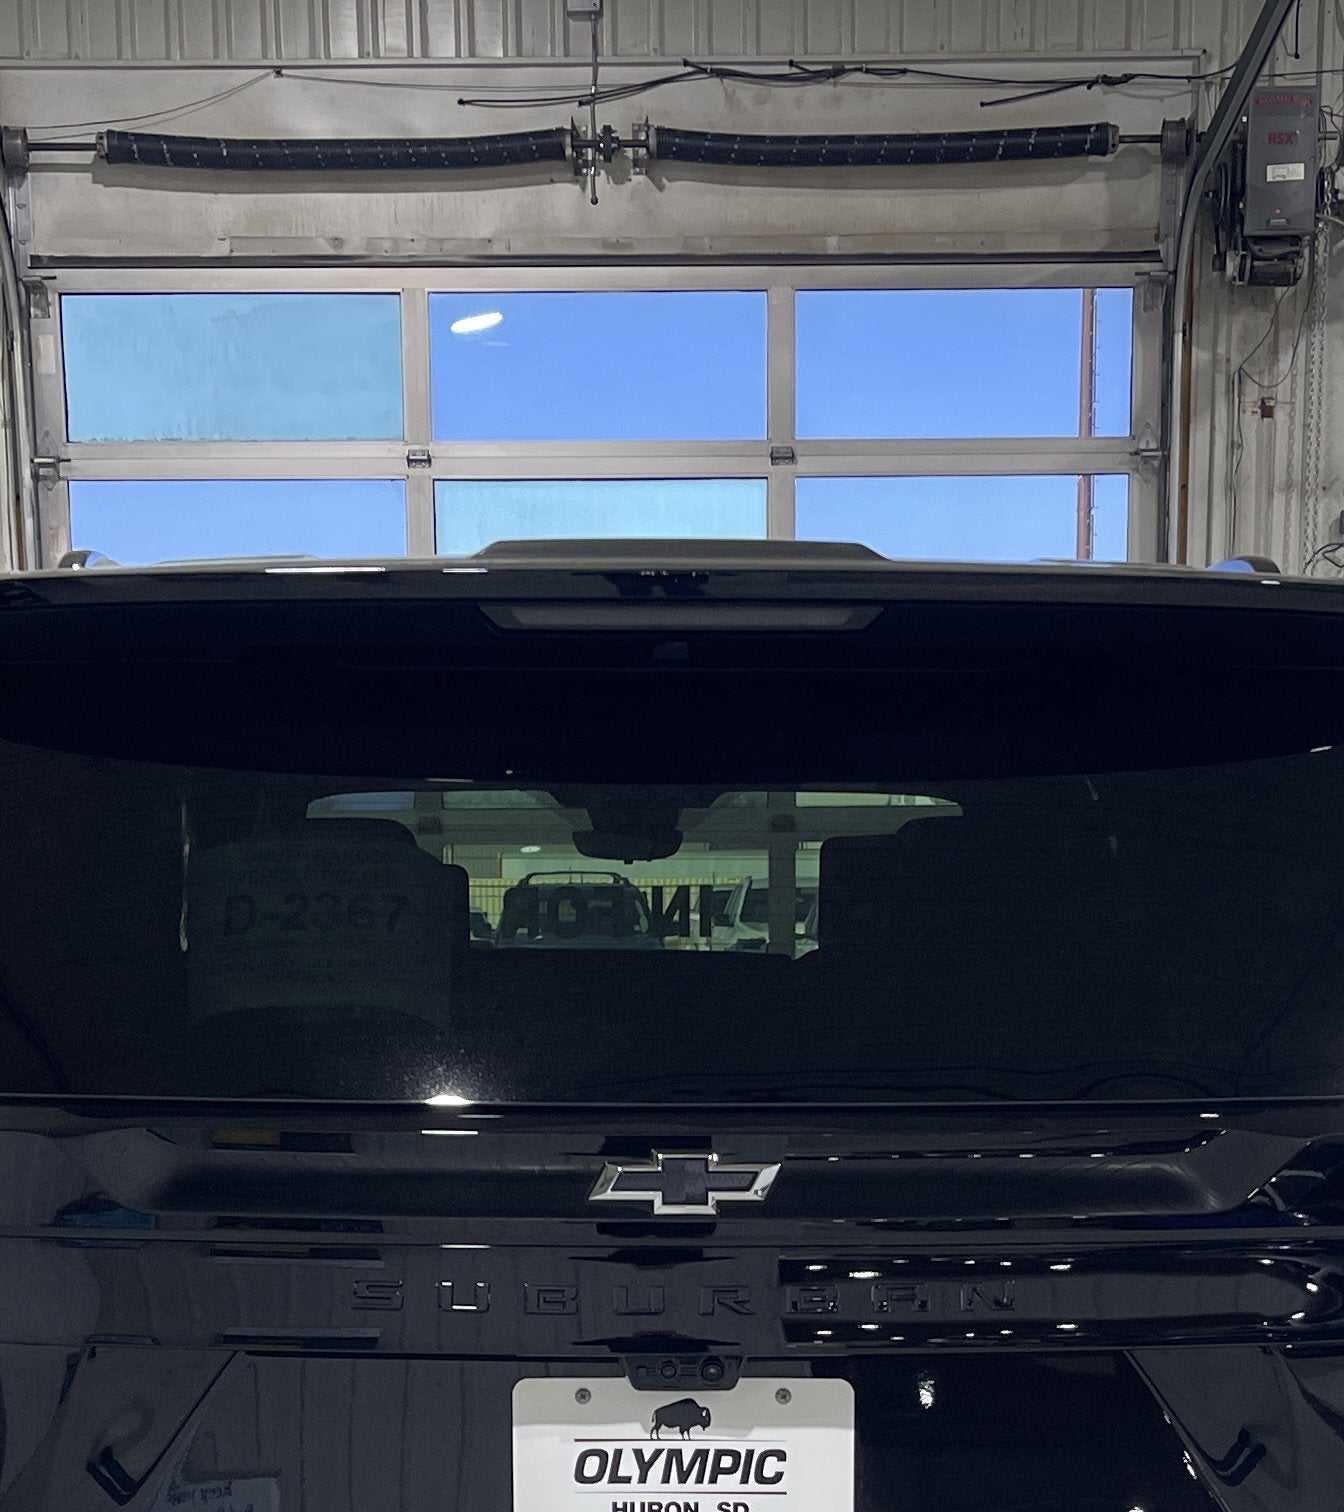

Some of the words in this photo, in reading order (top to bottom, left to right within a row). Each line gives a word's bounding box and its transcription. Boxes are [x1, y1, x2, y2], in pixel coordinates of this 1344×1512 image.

[1268, 132, 1294, 145] RSX
[352, 1279, 1016, 1315] SUBURBAN
[574, 1447, 787, 1486] OLYMPIC
